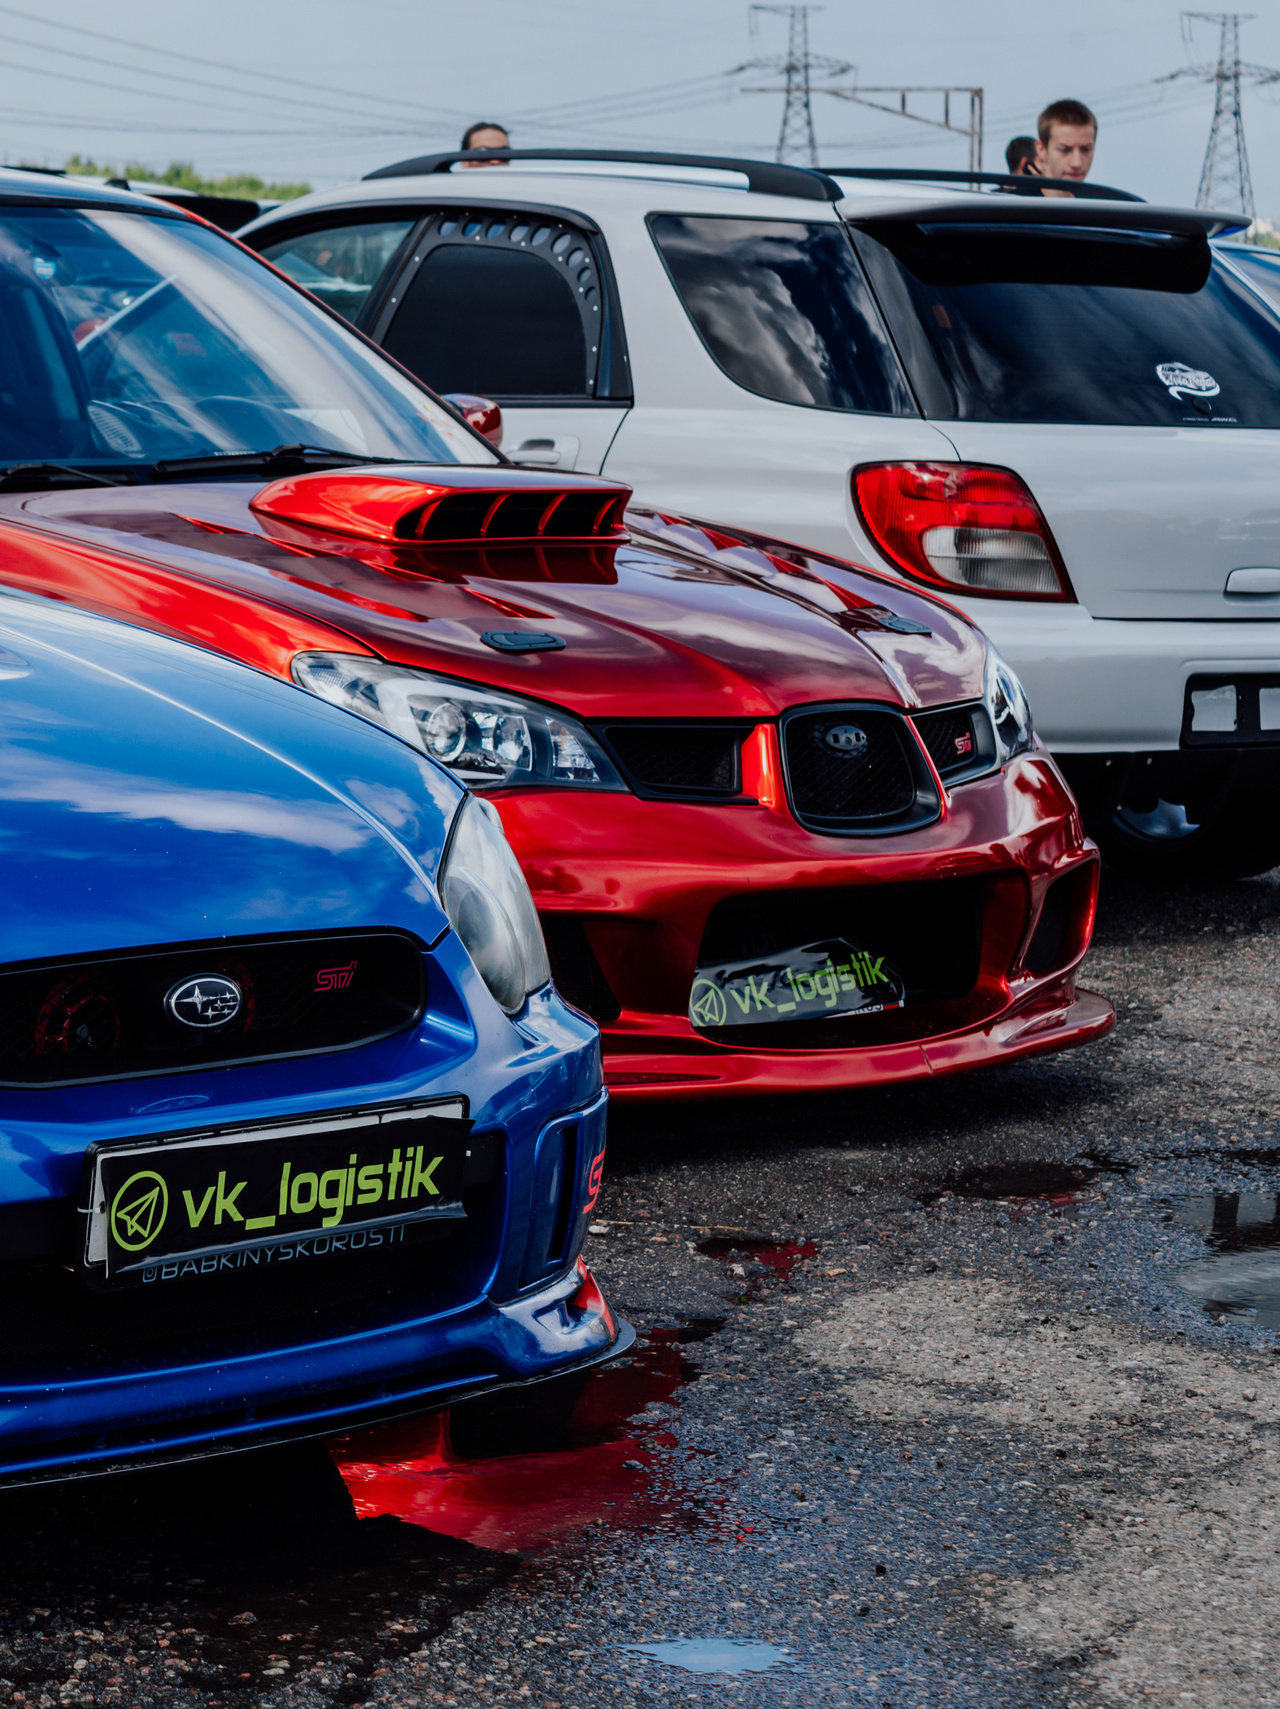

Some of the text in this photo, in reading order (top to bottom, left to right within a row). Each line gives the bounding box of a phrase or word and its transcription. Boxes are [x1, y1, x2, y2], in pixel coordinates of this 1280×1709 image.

[730, 951, 890, 1014] vk_logistik
[182, 1145, 445, 1230] vk_logistik
[161, 1225, 406, 1280] BABKINYSKOROSTI
